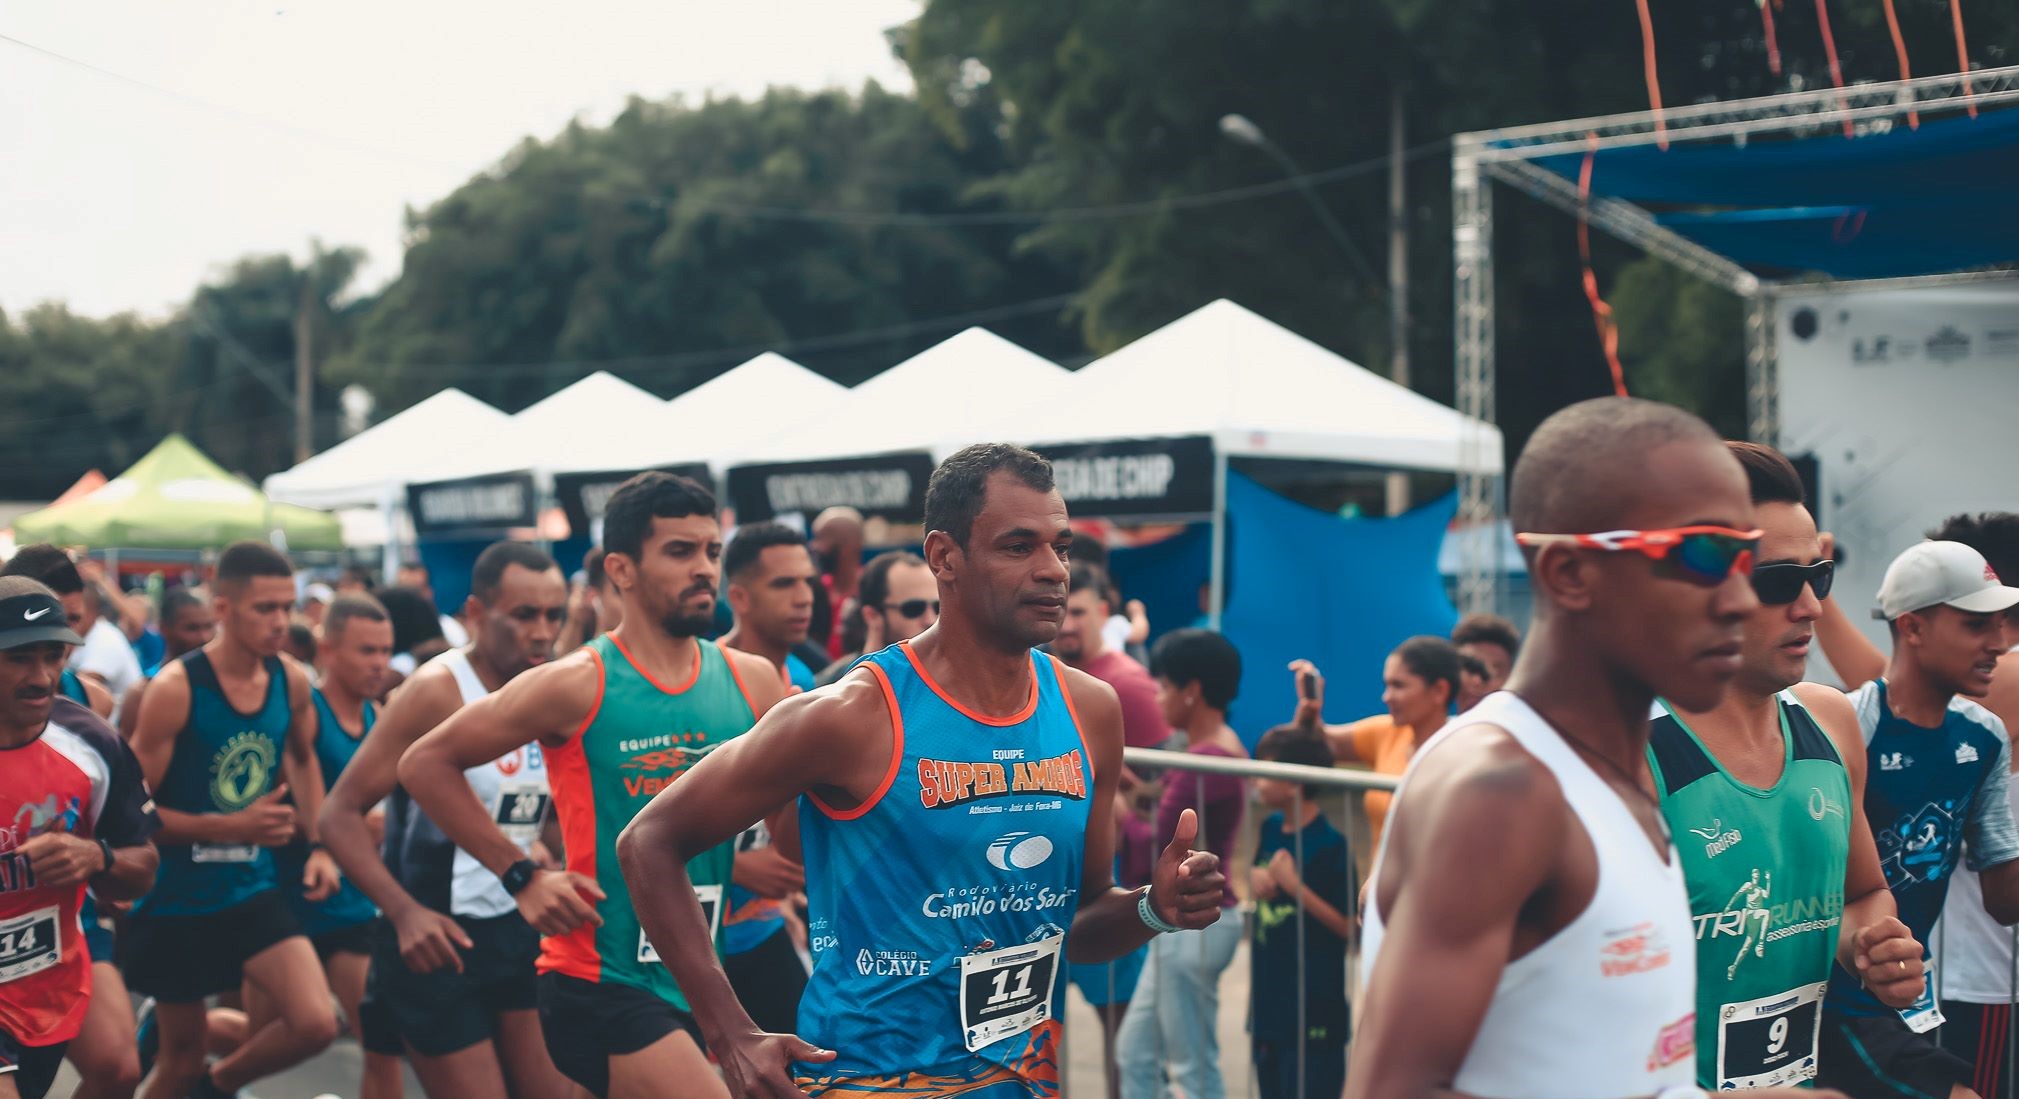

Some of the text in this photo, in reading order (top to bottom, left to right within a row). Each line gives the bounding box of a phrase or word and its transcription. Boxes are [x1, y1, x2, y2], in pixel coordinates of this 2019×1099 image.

[1123, 453, 1174, 498] CHIP
[619, 735, 671, 752] EQUIPE
[992, 749, 1024, 760] EQUIPE
[917, 749, 1087, 808] SUPER AMIGOS
[510, 794, 540, 819] 20
[969, 805, 1003, 815] Atletismo
[922, 893, 996, 920] Camilo
[1000, 893, 1034, 913] dos
[1, 926, 37, 955] 14
[875, 949, 917, 960] COLÉGIO
[876, 960, 932, 976] CAVE
[987, 964, 1033, 1005] 11
[1767, 1016, 1789, 1054] 9
